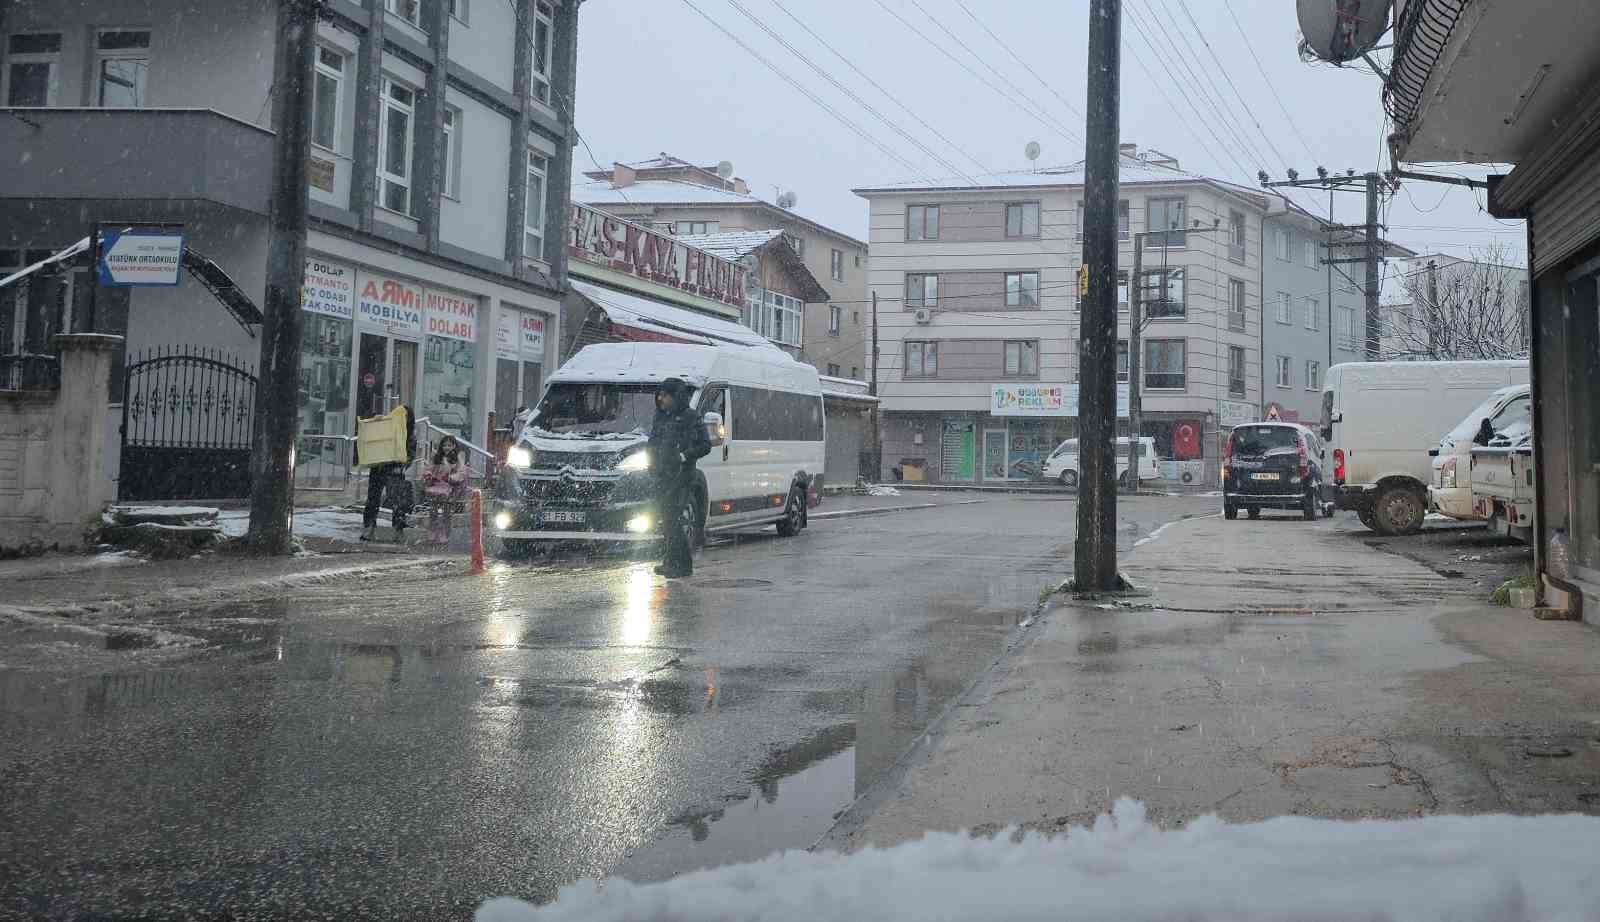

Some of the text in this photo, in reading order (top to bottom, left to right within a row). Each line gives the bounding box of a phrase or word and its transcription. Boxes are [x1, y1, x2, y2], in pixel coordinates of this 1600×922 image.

[360, 302, 419, 323] MOBİLYA
[427, 294, 475, 318] MUTFAK
[429, 317, 472, 339] DOLABI
